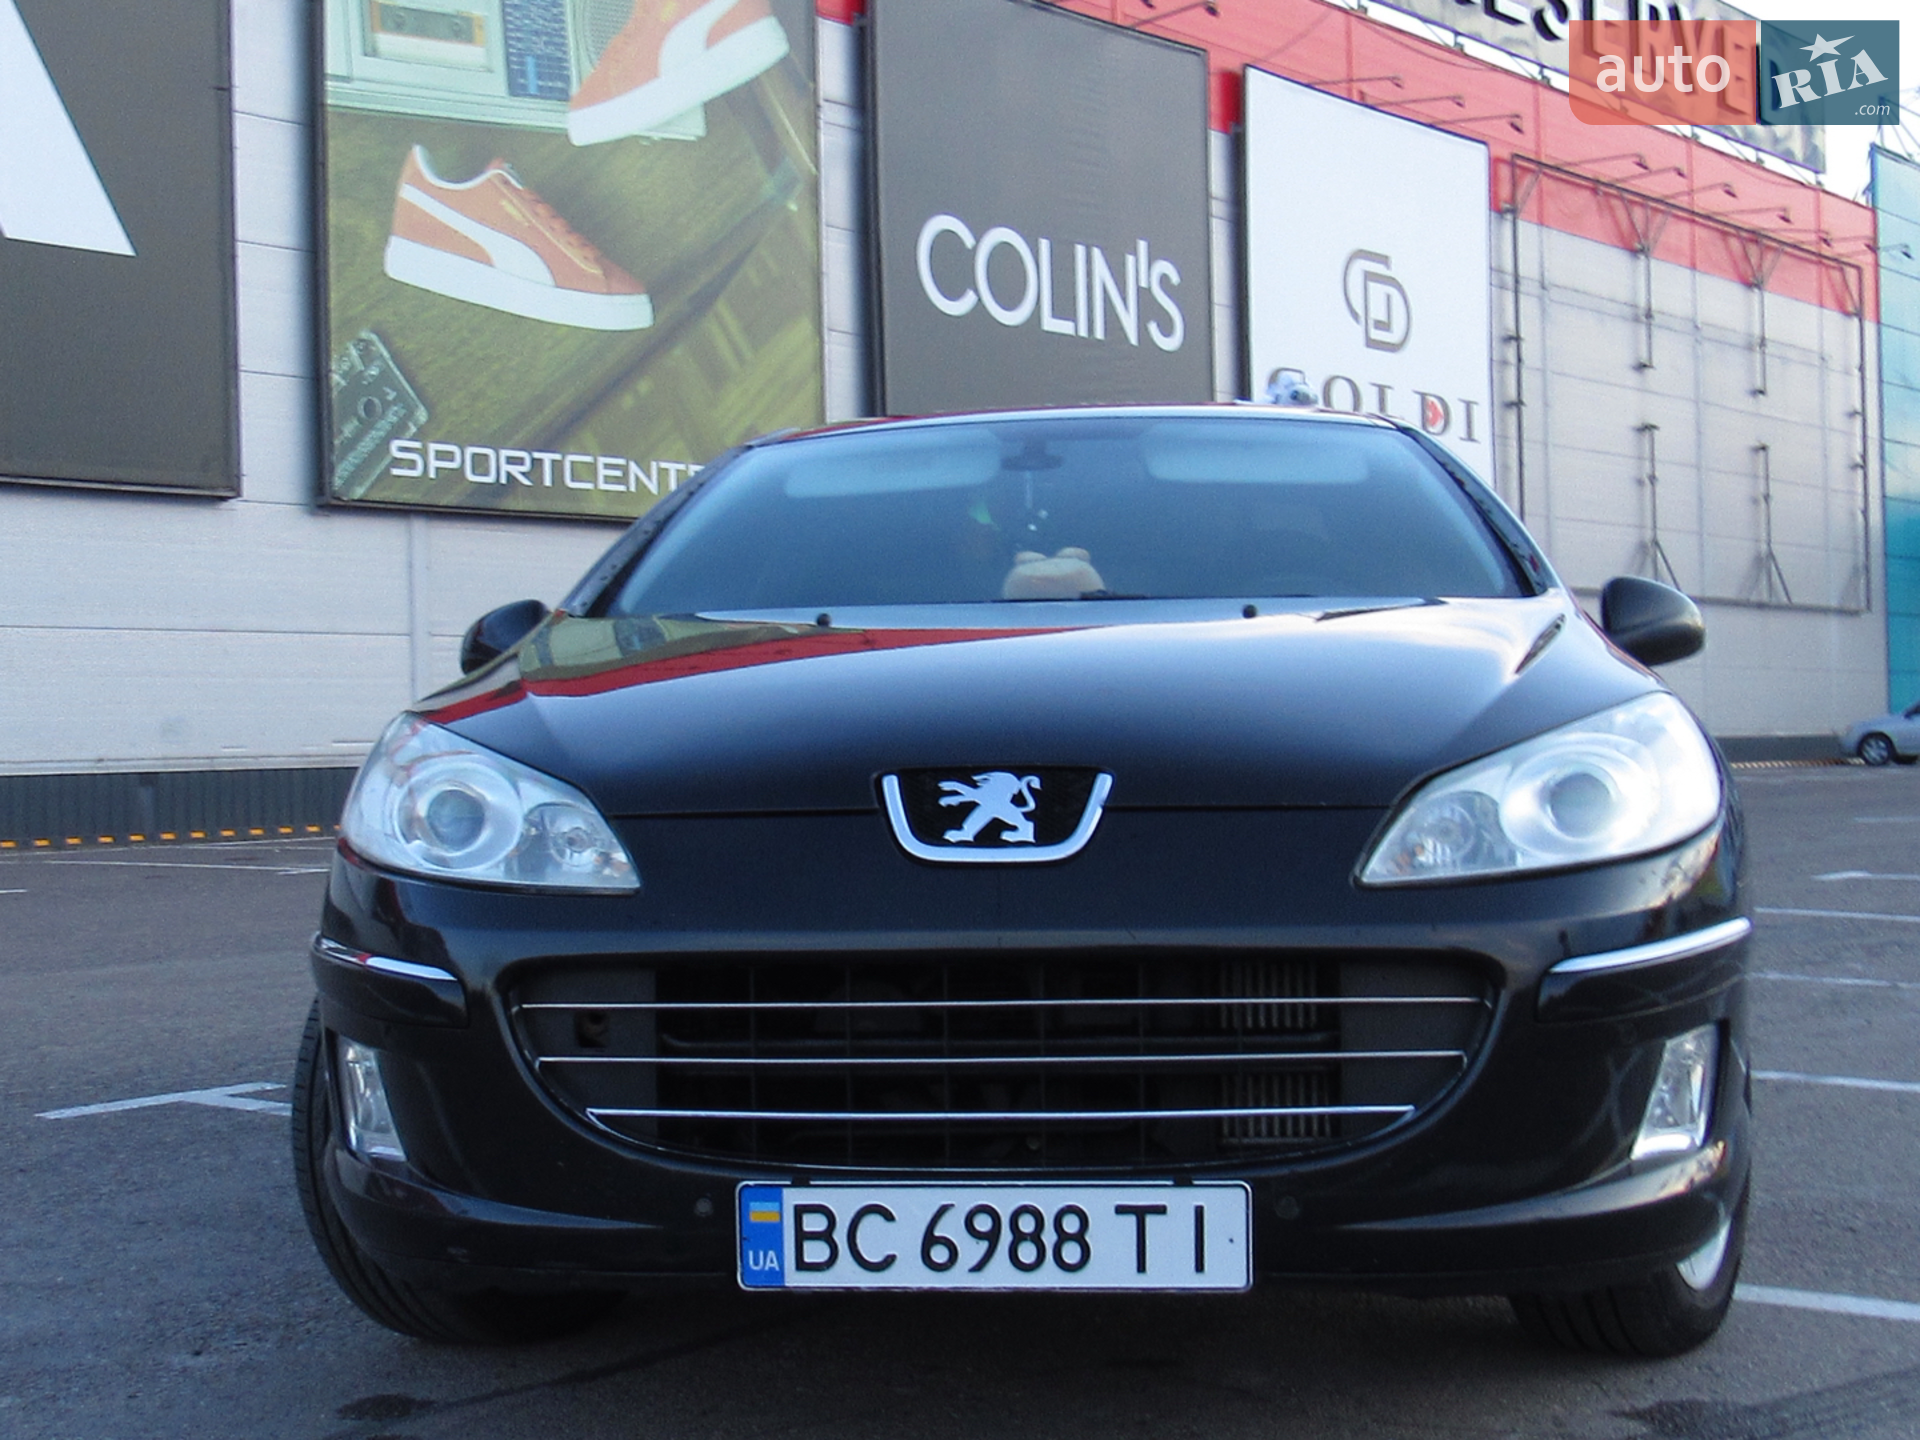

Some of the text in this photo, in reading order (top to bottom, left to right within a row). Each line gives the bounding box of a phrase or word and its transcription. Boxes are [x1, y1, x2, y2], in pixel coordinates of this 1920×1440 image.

[916, 214, 1186, 352] COLIN'S
[389, 438, 705, 495] SPORTCENT
[749, 1249, 780, 1272] UA
[794, 1203, 1204, 1273] BC 6988 TI
